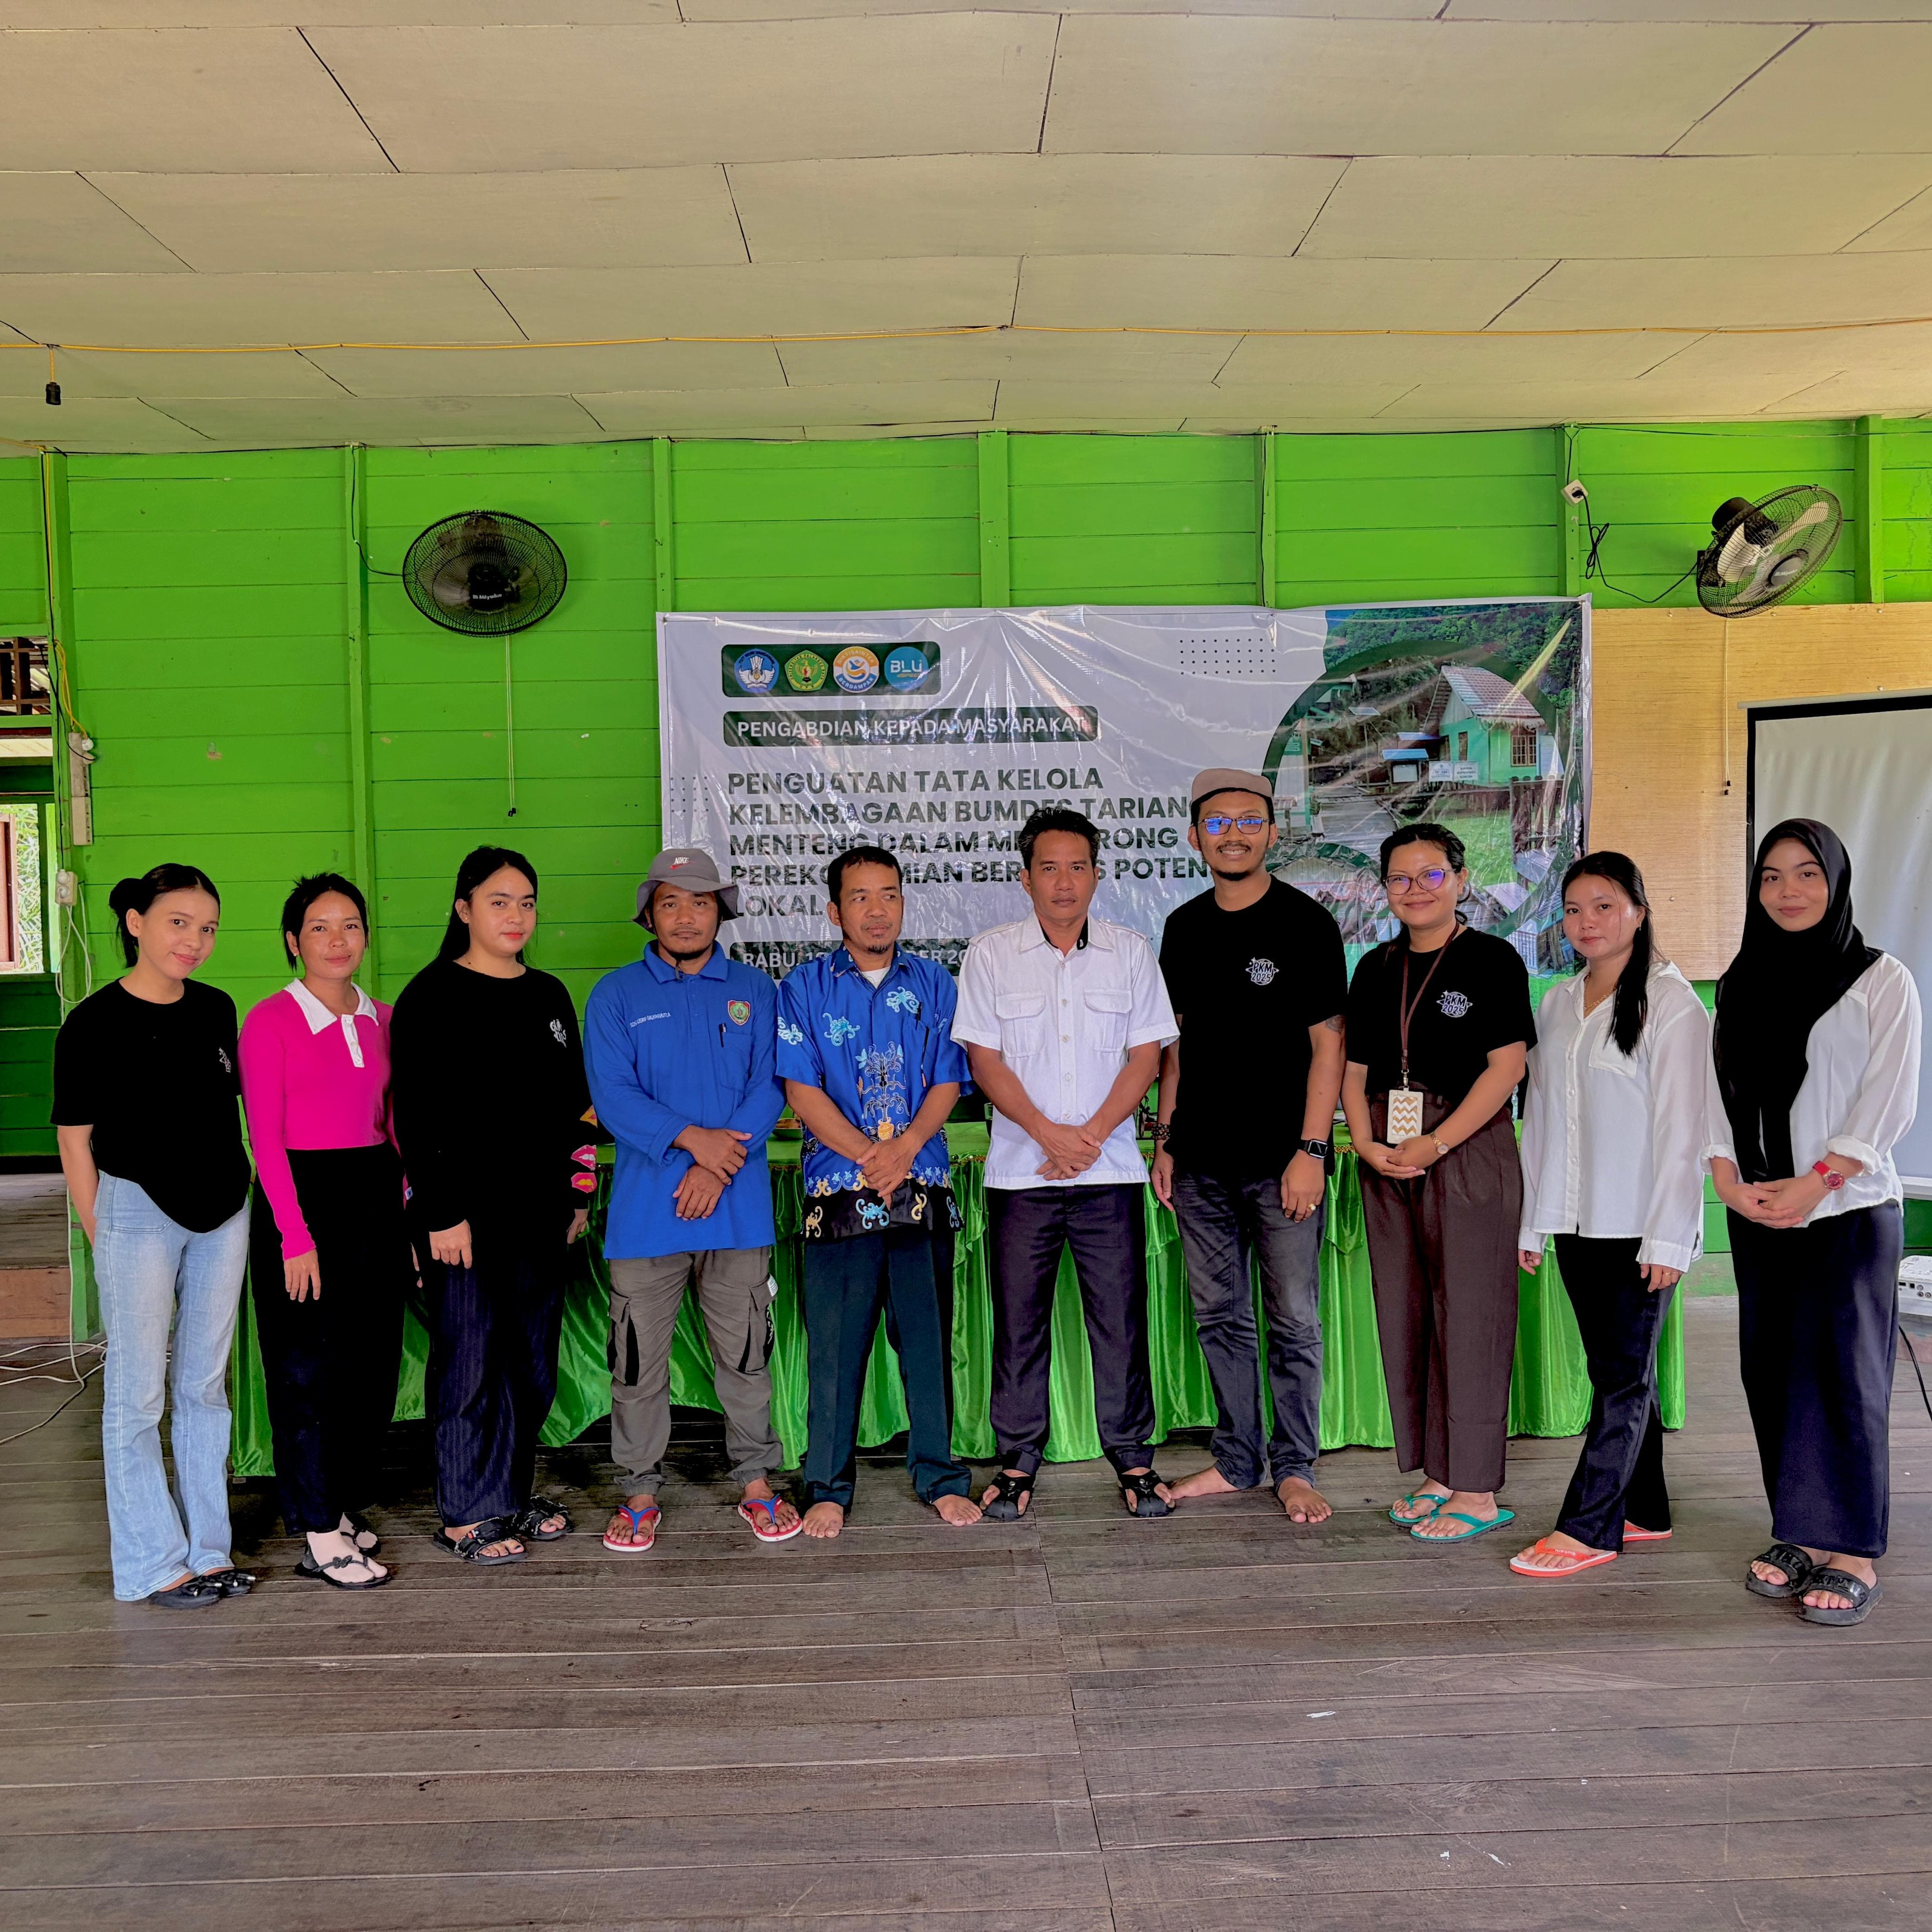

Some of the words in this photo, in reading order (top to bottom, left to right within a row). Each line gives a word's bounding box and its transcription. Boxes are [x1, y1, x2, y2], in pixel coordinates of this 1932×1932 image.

[838, 677, 875, 689] BERDAMPAK
[738, 720, 867, 737] PENGABDIAN
[875, 719, 950, 736] KEPADA
[957, 717, 1084, 734] MASYARAKAT
[728, 771, 907, 795] PENGUATAN
[914, 770, 991, 792] TATA
[998, 768, 1104, 790] KELOLA
[729, 801, 946, 825] KELEMBAGAAN
[1080, 796, 1192, 819] TARIAN
[730, 833, 869, 856] MENTENG
[877, 830, 979, 854] DALAM
[1253, 962, 1273, 973] PKM
[1252, 973, 1271, 982] 2025
[1445, 995, 1467, 1007] PKM
[1442, 1004, 1463, 1015] 2025
